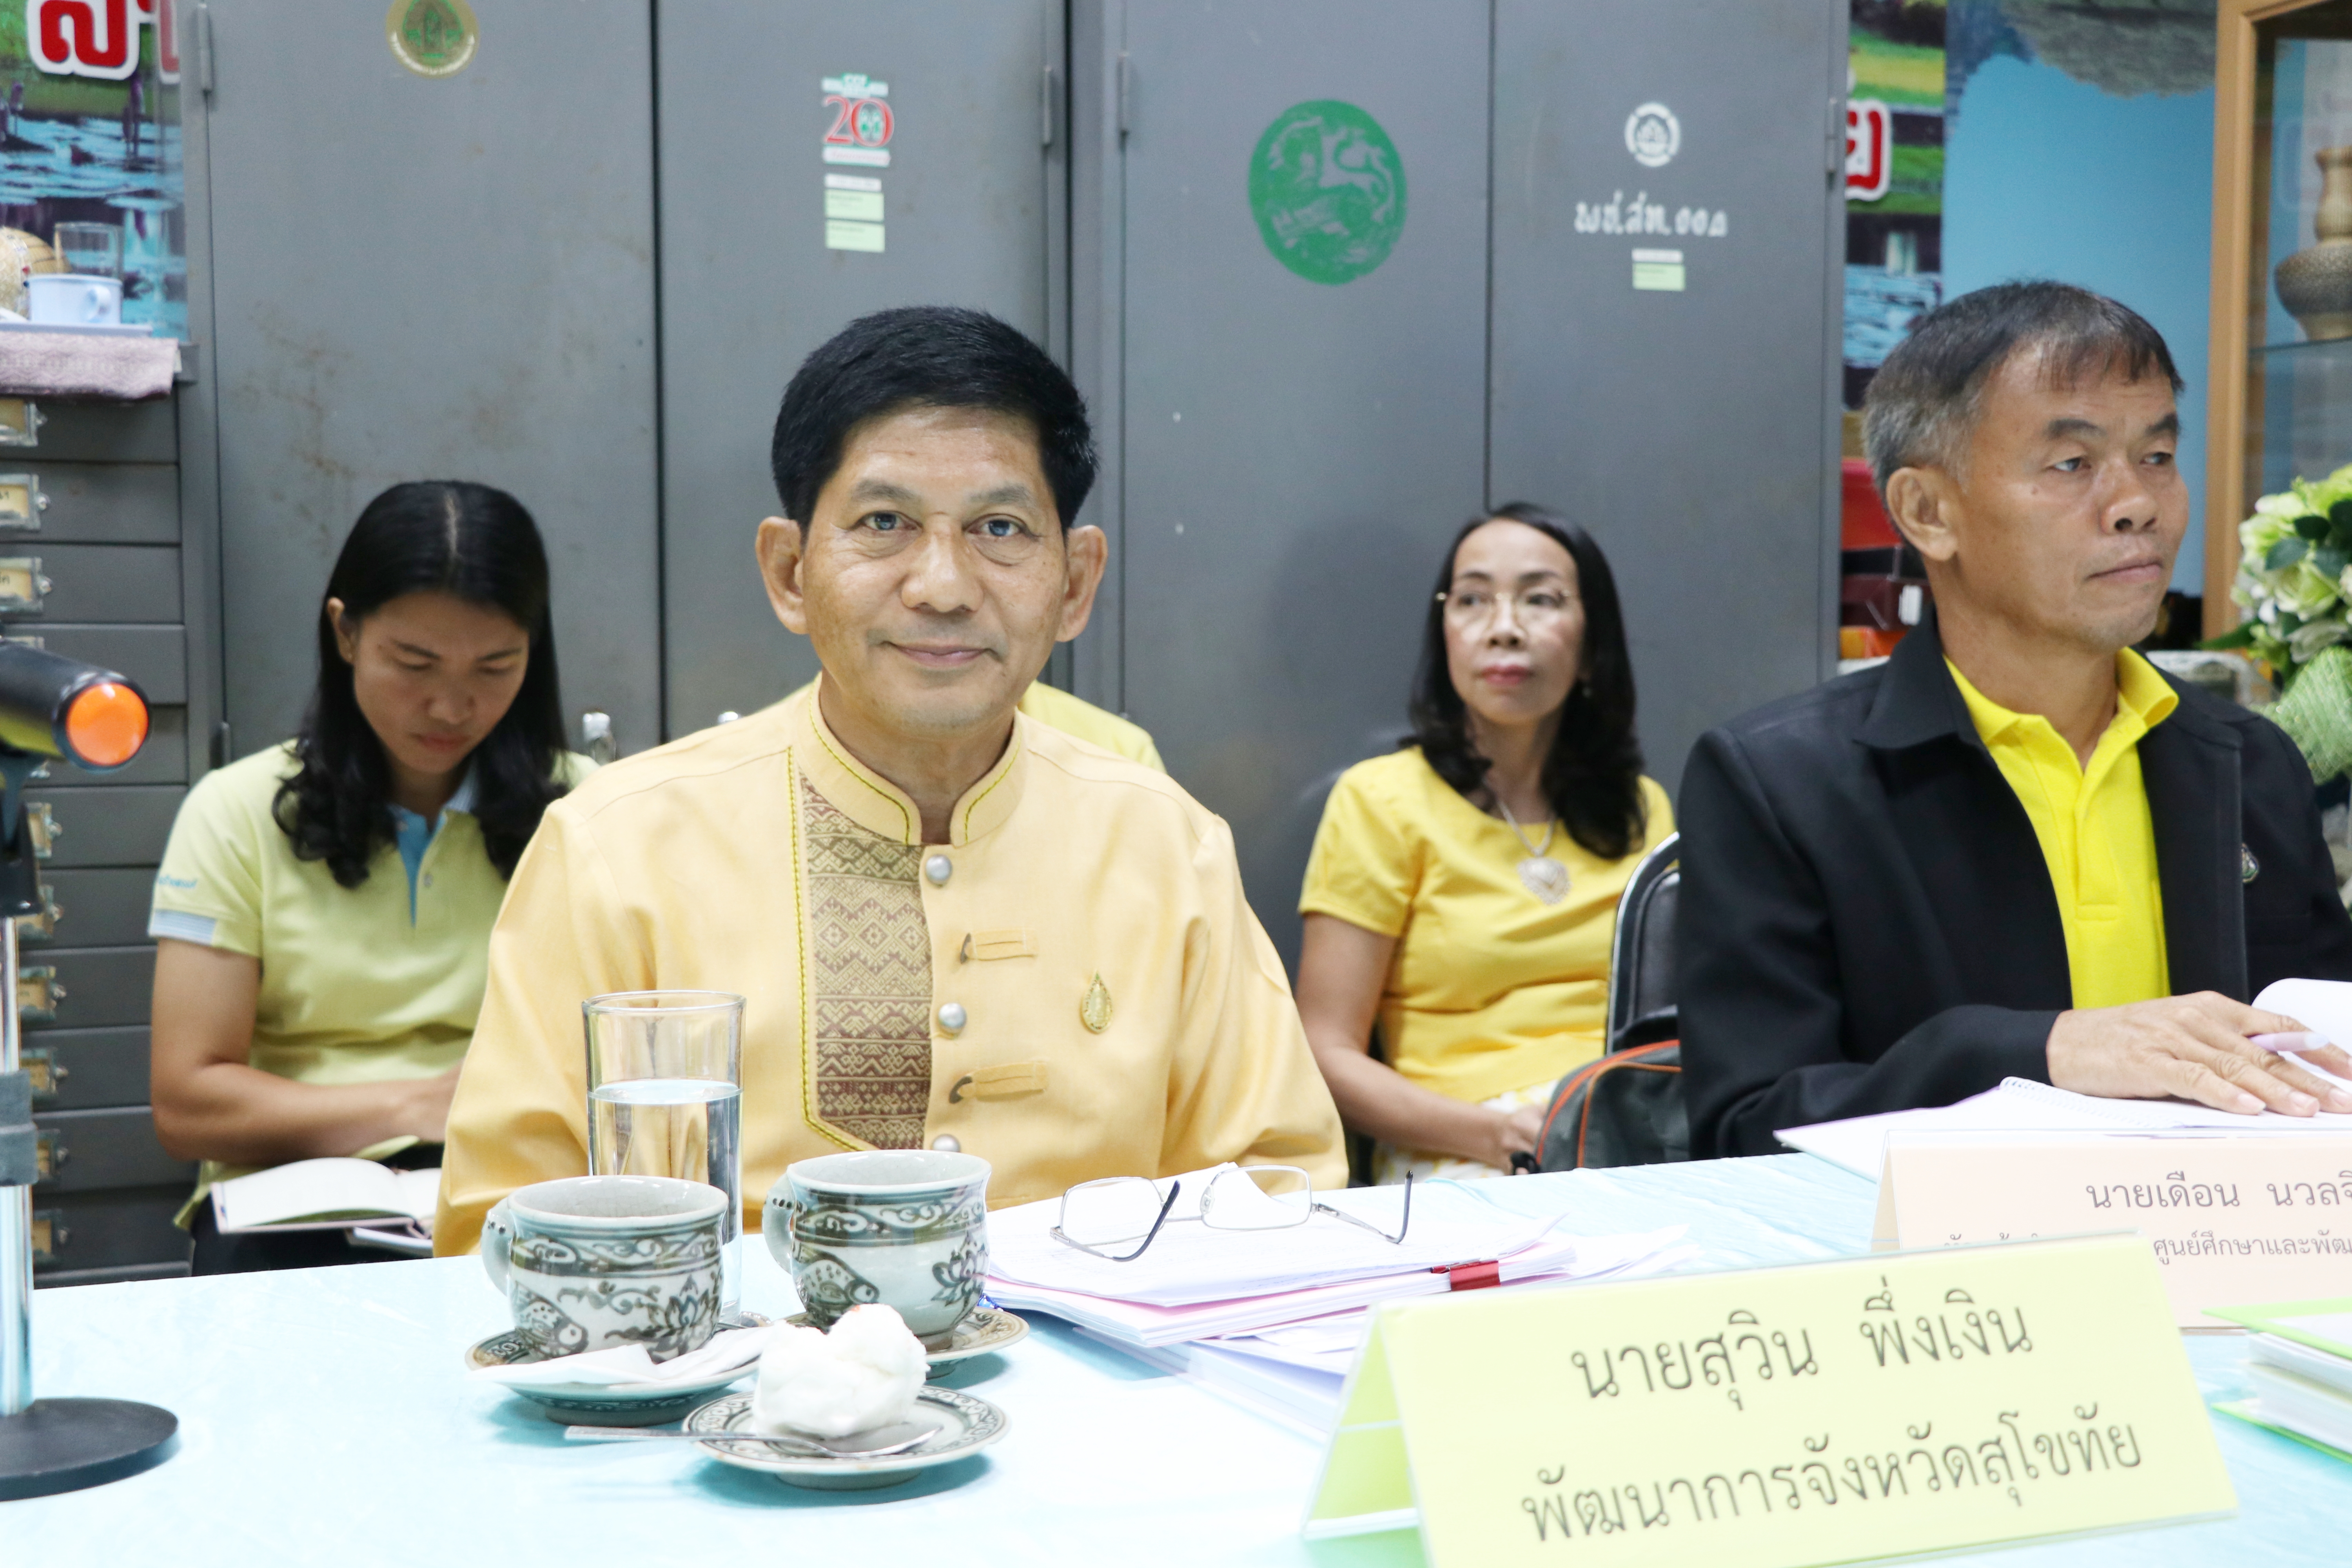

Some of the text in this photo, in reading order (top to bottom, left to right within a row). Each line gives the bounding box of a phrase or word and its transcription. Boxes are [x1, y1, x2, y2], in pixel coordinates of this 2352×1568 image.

[822, 94, 894, 147] 20
[2085, 1171, 2240, 1208] นายเดือน
[1571, 1275, 2033, 1411] นายสุวิน พึ่งเงิน
[1522, 1402, 2141, 1542] พัฒนาการจังหวัดสุโขทัย
